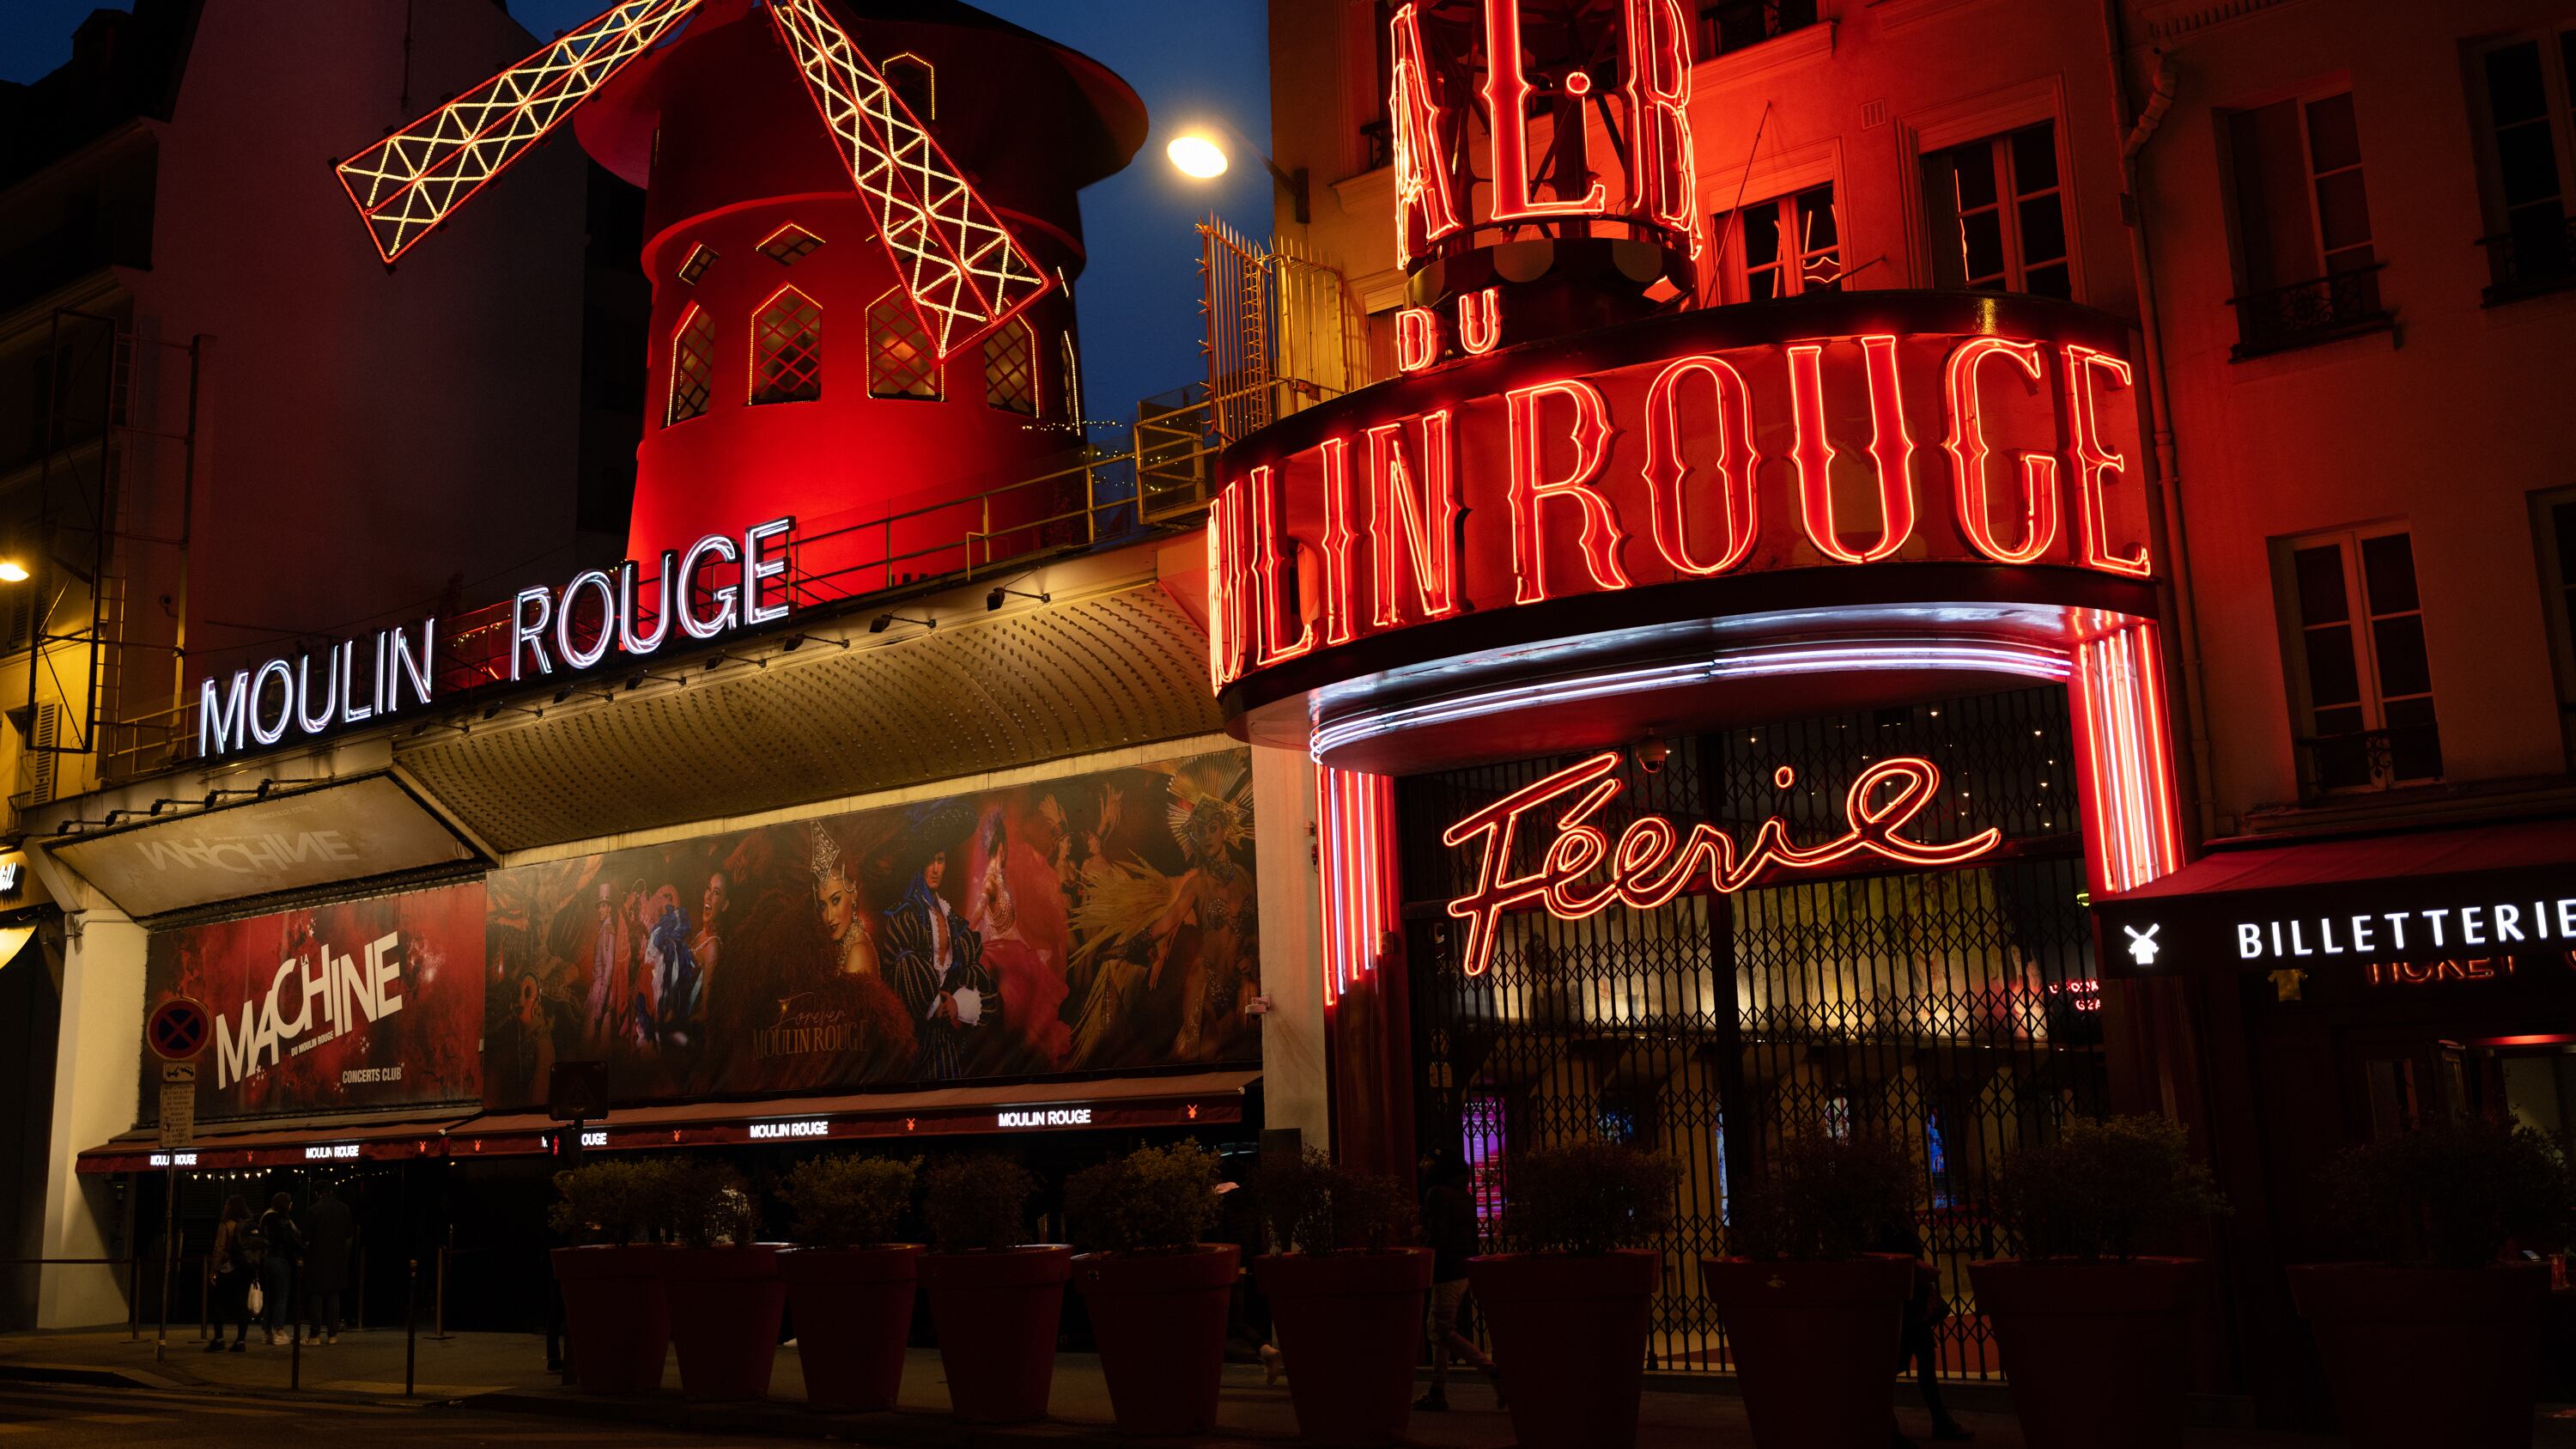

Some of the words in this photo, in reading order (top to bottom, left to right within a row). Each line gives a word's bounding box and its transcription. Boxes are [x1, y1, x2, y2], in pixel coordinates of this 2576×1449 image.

[1396, 287, 1503, 372] DU
[1505, 334, 2152, 606] ROUGE
[198, 615, 435, 758] MOULIN
[510, 515, 793, 684] ROUGE
[1443, 751, 2002, 977] Féerie
[2237, 896, 2576, 960] BILLETTERIE
[301, 953, 309, 966] LA
[216, 930, 403, 1091] MACHINE
[769, 991, 848, 1030] Forever
[290, 1045, 298, 1057] DU
[298, 1038, 317, 1054] MOULIN
[318, 1031, 334, 1045] ROUGE
[751, 1026, 811, 1059] MOULIN
[812, 1019, 870, 1052] ROUGE
[343, 1068, 380, 1084] CONCERTS
[382, 1067, 402, 1081] CLUB
[750, 1123, 789, 1138] MOULIN
[791, 1121, 829, 1136] ROUGE
[998, 1111, 1045, 1128] MOULIN
[1048, 1109, 1091, 1124] ROUGE
[306, 1147, 333, 1159] MOULIN
[334, 1145, 360, 1158] ROUGE
[581, 1132, 607, 1146] OUGE
[150, 1154, 170, 1166] MOULI
[174, 1154, 197, 1166] ROUGE
